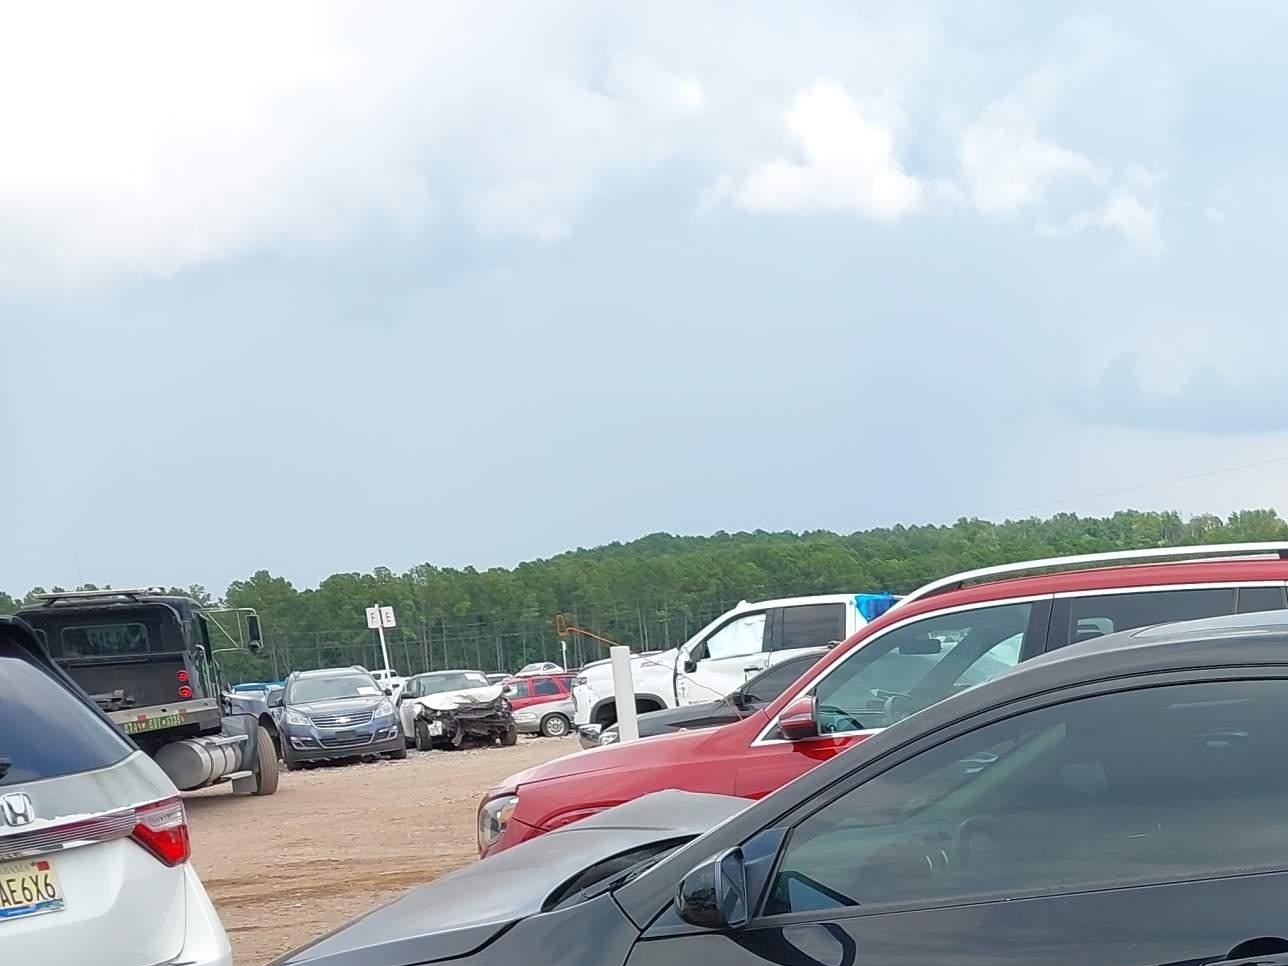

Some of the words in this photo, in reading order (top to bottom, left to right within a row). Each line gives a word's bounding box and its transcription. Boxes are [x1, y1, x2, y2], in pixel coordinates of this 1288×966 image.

[370, 612, 376, 624] F
[385, 611, 392, 623] E
[0, 874, 56, 907] AE6X6
